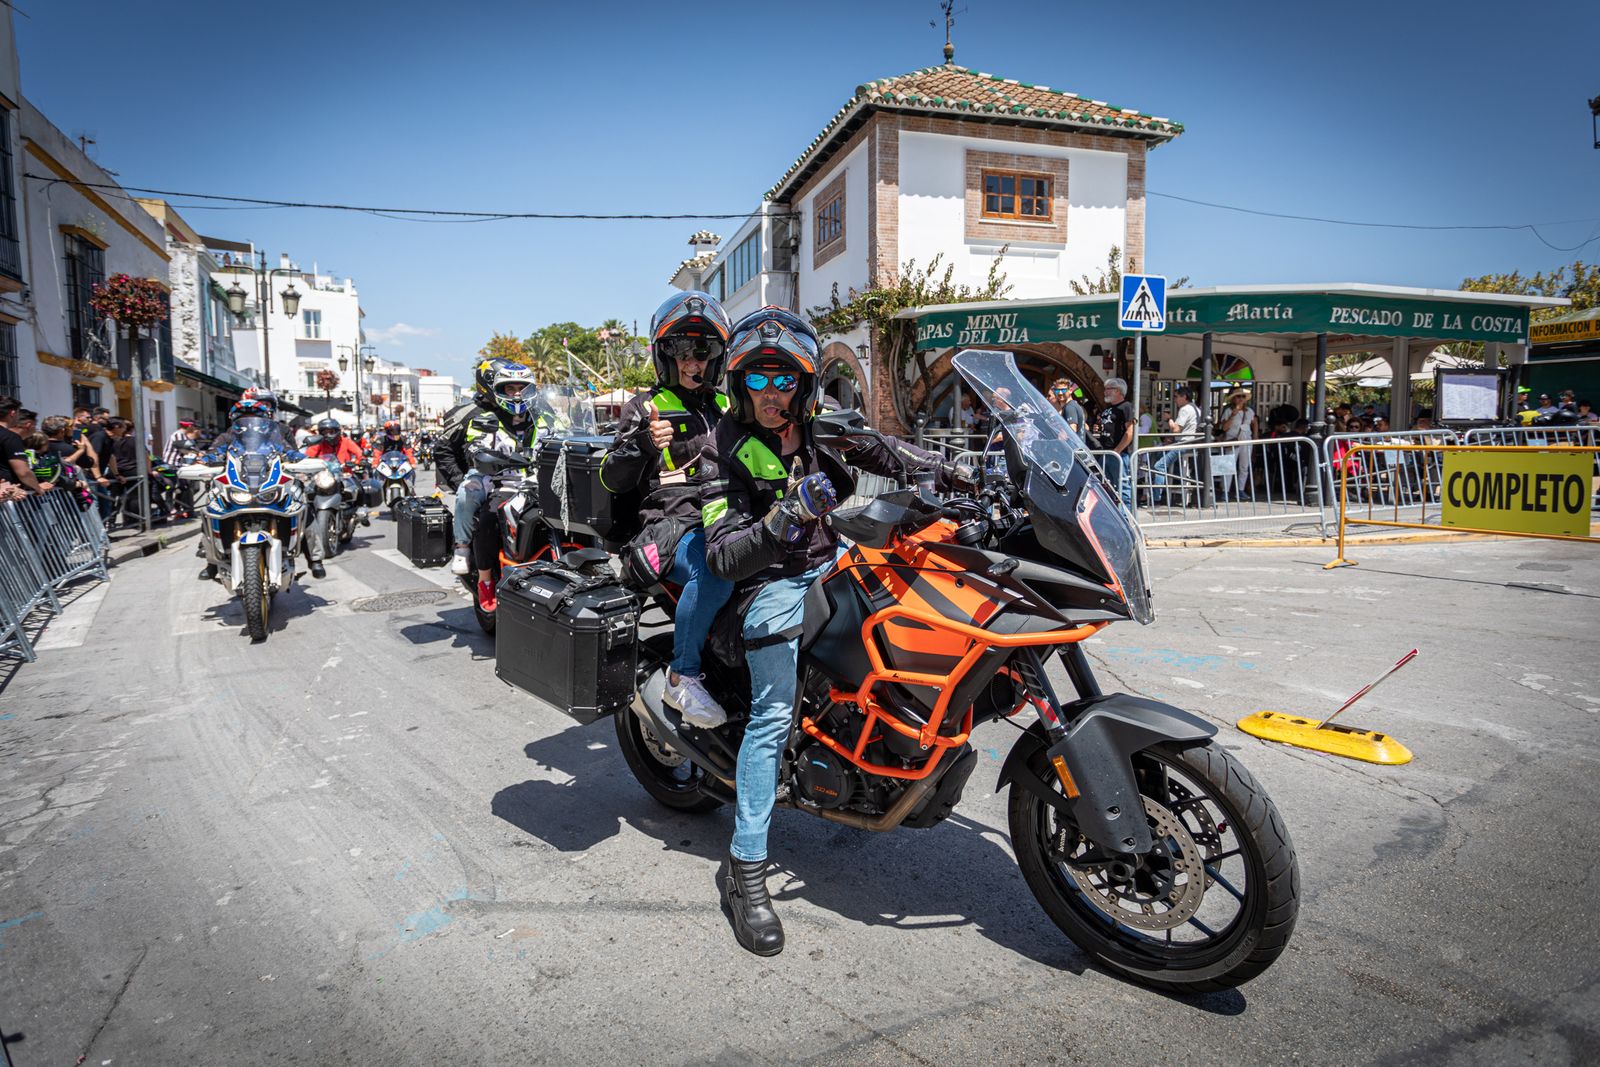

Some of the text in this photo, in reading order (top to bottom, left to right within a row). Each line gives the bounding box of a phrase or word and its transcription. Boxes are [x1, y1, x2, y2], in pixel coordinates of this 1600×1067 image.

[965, 313, 1018, 330] MENU
[1056, 312, 1100, 331] Bar
[1225, 303, 1293, 322] María
[1329, 307, 1523, 333] PESCADO DE LA COSTA
[916, 322, 954, 342] TAPAS
[957, 328, 1029, 345] DEL DIA
[1447, 471, 1585, 515] COMPLETO
